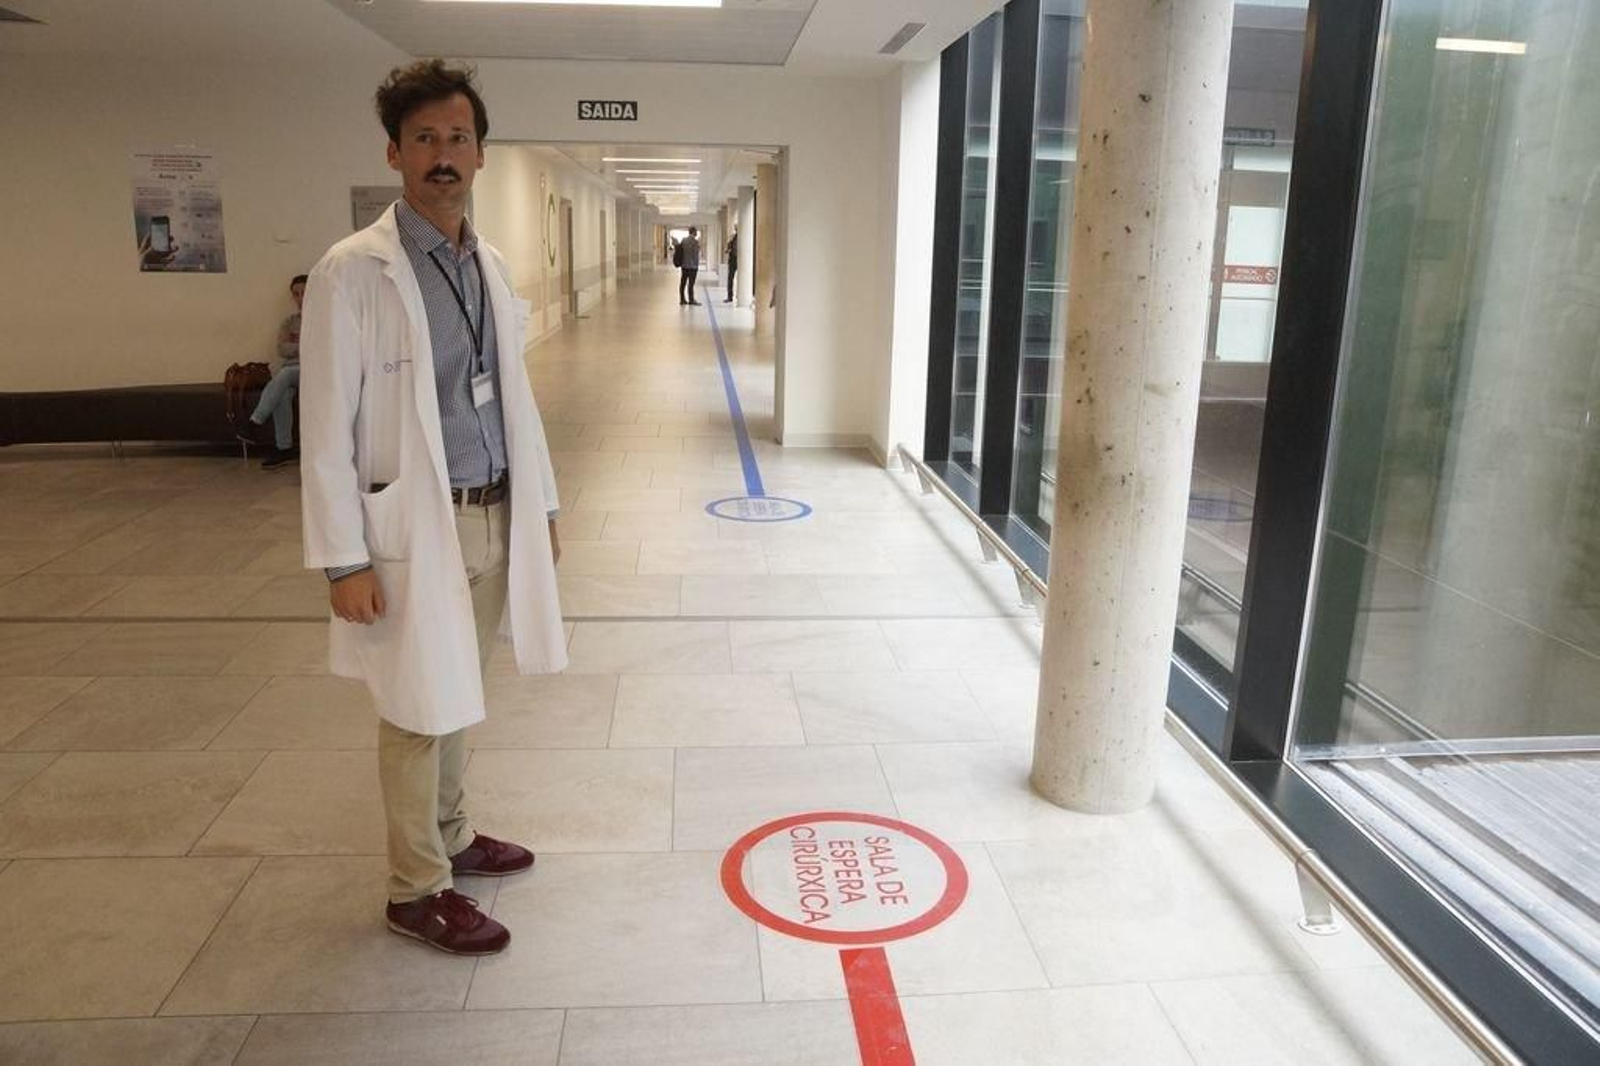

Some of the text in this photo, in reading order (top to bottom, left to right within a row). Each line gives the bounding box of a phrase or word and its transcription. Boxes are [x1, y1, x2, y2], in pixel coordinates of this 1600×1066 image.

[580, 102, 635, 119] SAIDA
[790, 826, 832, 924] CIRÚRXICA
[828, 840, 867, 904] ESPERA
[864, 836, 909, 905] SALA DE
